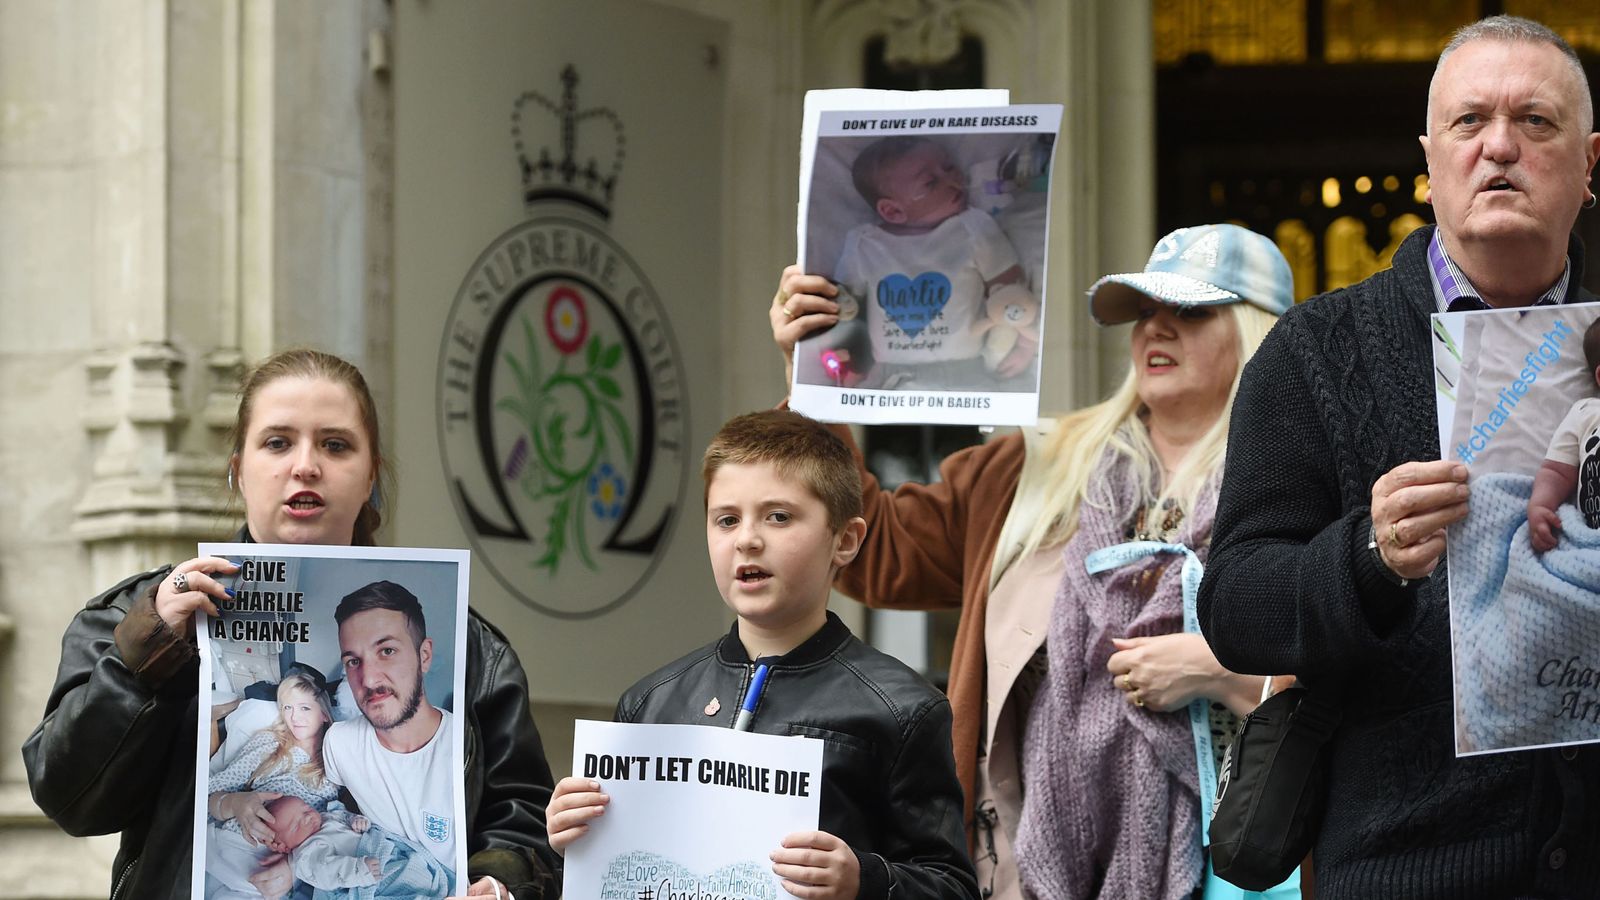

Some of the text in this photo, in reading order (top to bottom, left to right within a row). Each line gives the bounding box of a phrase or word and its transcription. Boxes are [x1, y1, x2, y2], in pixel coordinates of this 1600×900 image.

[842, 115, 1038, 130] DON'T GIVE UP ON RARE DISEASES
[446, 229, 681, 459] THE SUPREME COURT
[841, 393, 991, 409] DON'T GIVE UP ON BABIES
[1456, 319, 1574, 465] #charliesfight
[1586, 461, 1600, 478] MY
[242, 560, 286, 582] GIVE
[214, 620, 310, 643] A CHANCE
[1552, 691, 1600, 723] Ar
[584, 753, 810, 798] DON'T LET CHARLIE DIE
[608, 865, 626, 882] Hope
[626, 856, 658, 882] Love
[601, 882, 636, 900] America
[672, 871, 695, 891] Love
[707, 875, 727, 893] Faith
[728, 868, 766, 899] America
